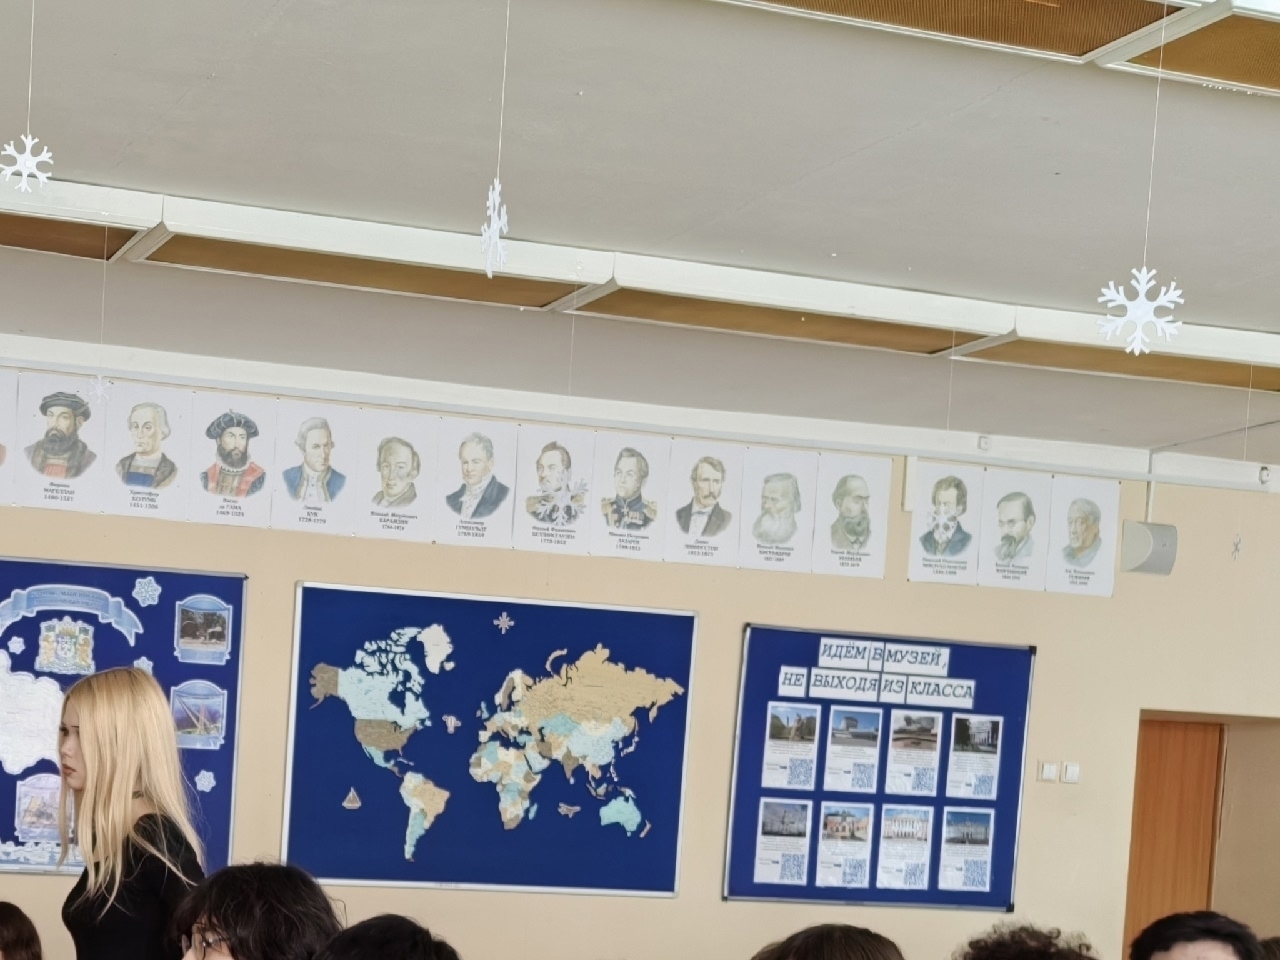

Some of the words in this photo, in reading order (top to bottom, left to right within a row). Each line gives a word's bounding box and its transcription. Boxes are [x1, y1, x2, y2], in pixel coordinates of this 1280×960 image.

[820, 641, 867, 661] ИДЁМ
[871, 646, 883, 662] В
[885, 646, 947, 670] МУЗЕЙ,
[781, 672, 805, 687] НЕ
[811, 673, 879, 693] ВЫХОДЯ
[882, 678, 905, 694] ИЗ
[908, 680, 973, 699] КЛАССА
